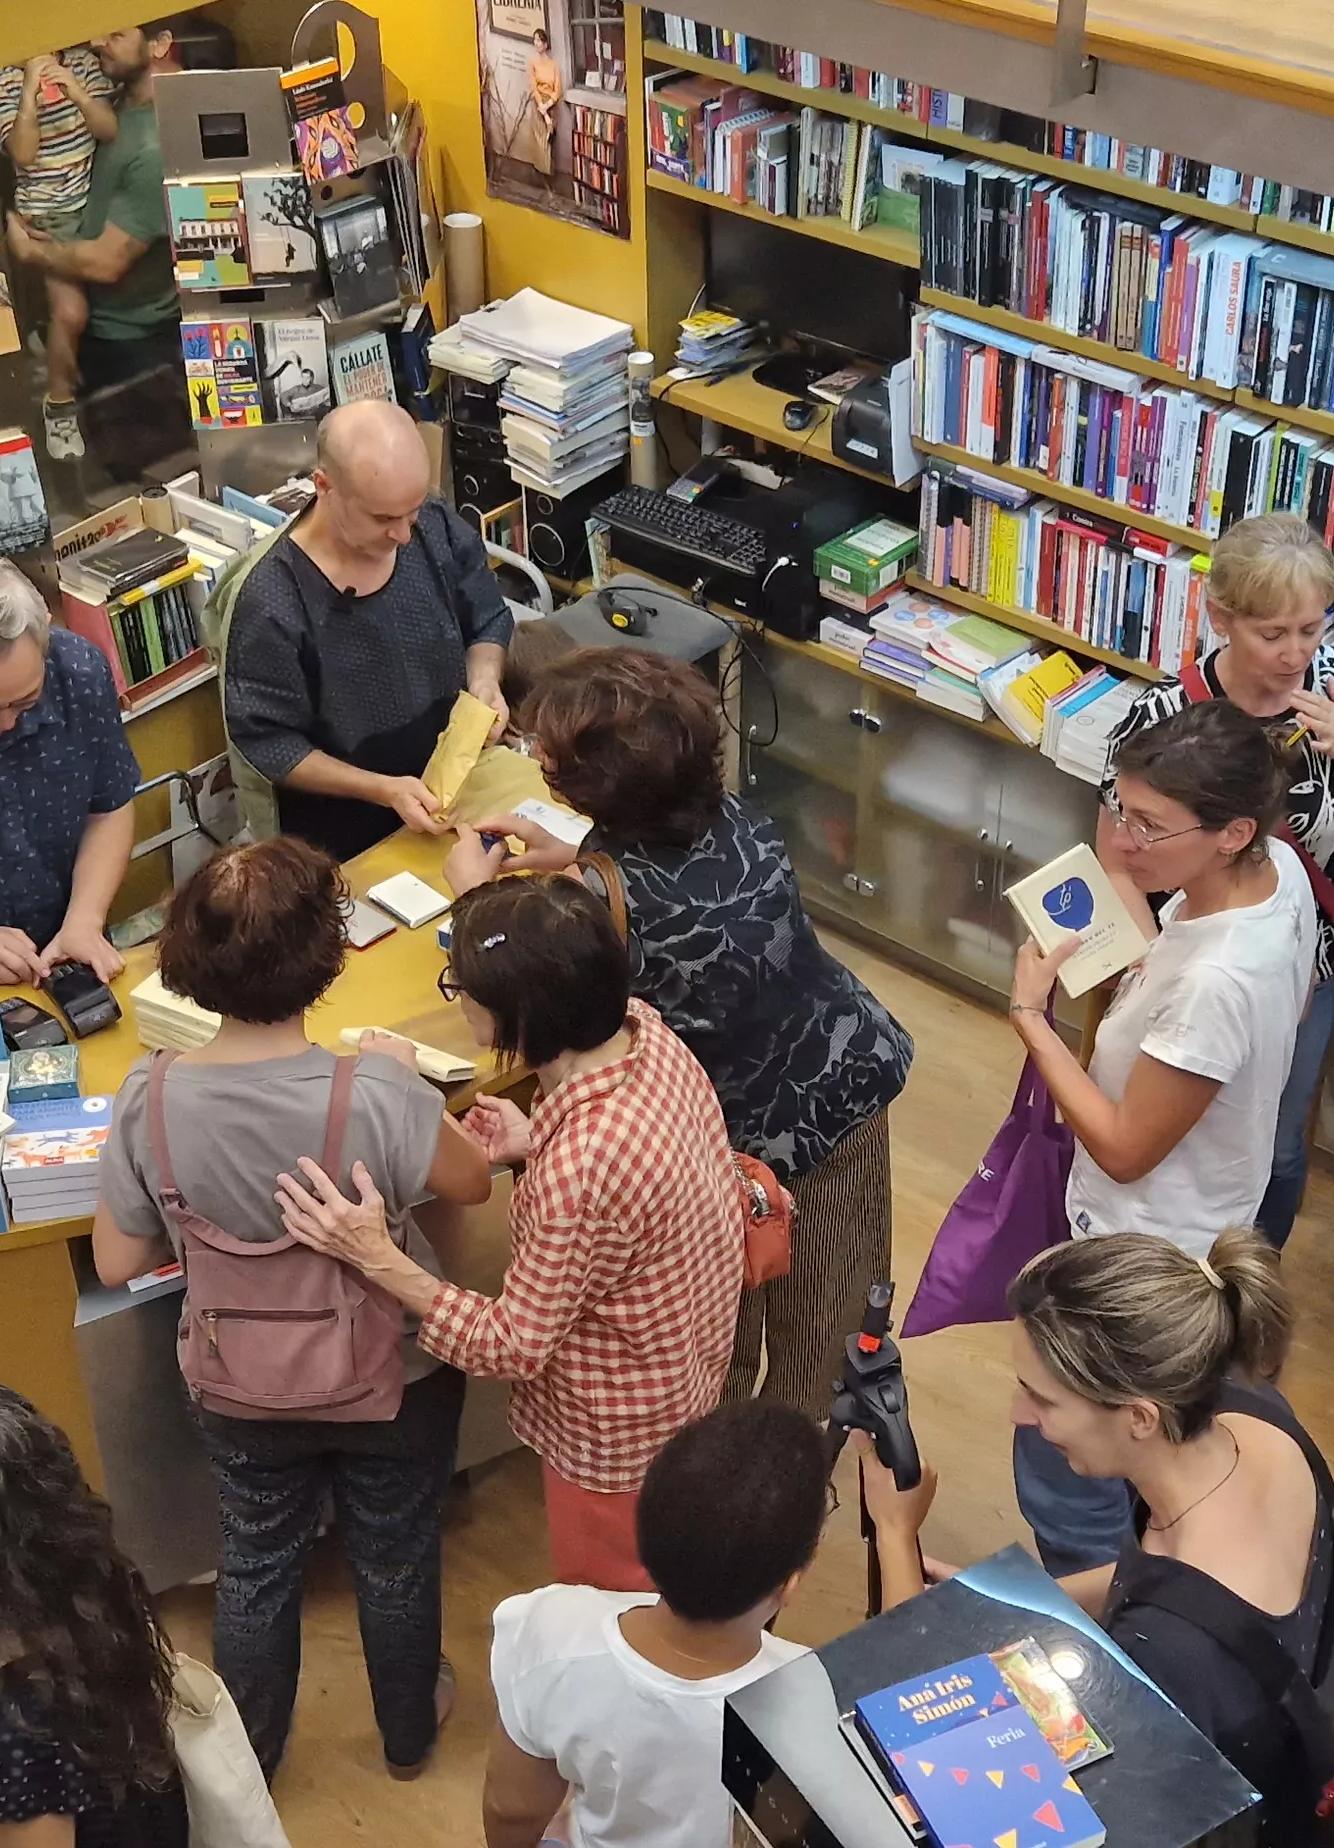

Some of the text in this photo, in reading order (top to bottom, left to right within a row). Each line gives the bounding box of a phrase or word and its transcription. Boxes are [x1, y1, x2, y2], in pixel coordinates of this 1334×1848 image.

[1226, 261, 1242, 336] CARLOS SAURA
[339, 343, 384, 374] CÁLLATE
[897, 1674, 974, 1712] Ana Iris
[912, 1692, 977, 1726] Simón
[986, 1726, 1026, 1749] Feria
